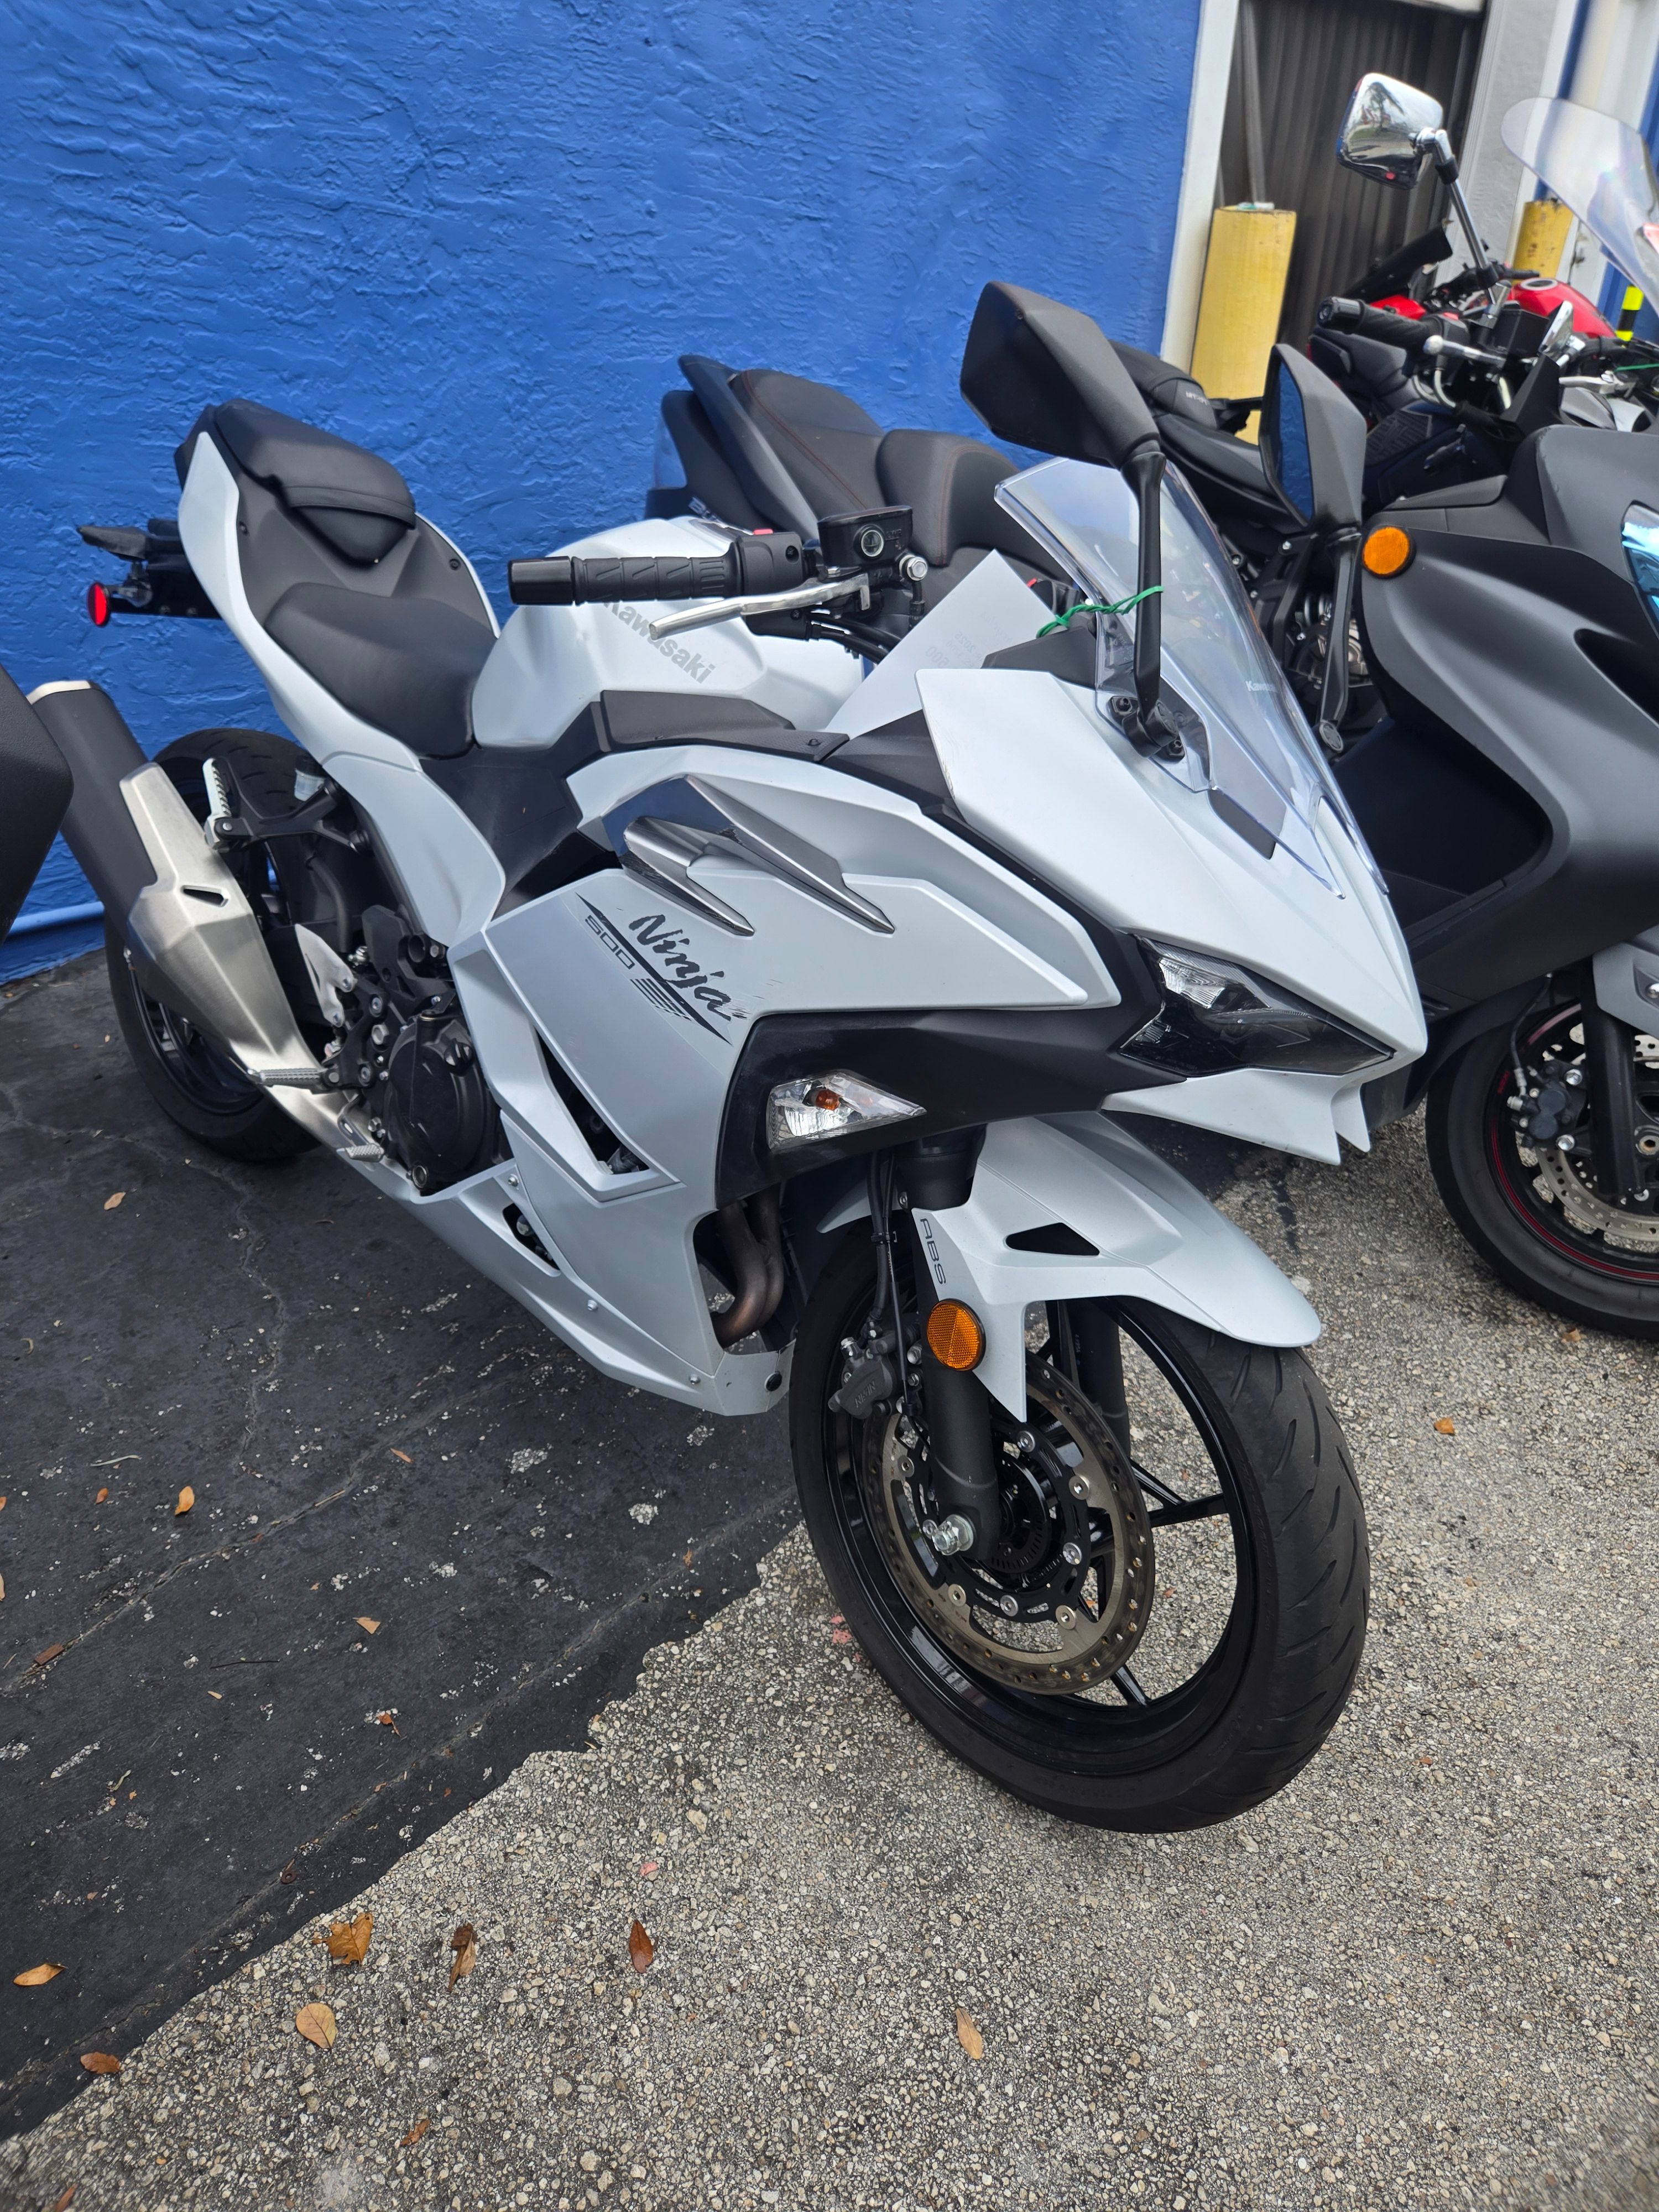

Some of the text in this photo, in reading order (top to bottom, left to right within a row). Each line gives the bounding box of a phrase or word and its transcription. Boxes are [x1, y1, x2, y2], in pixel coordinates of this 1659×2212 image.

[602, 602, 717, 684] awsaki
[585, 915, 635, 970] 500
[628, 914, 732, 1021] Ninja
[920, 1218, 946, 1285] ABS
